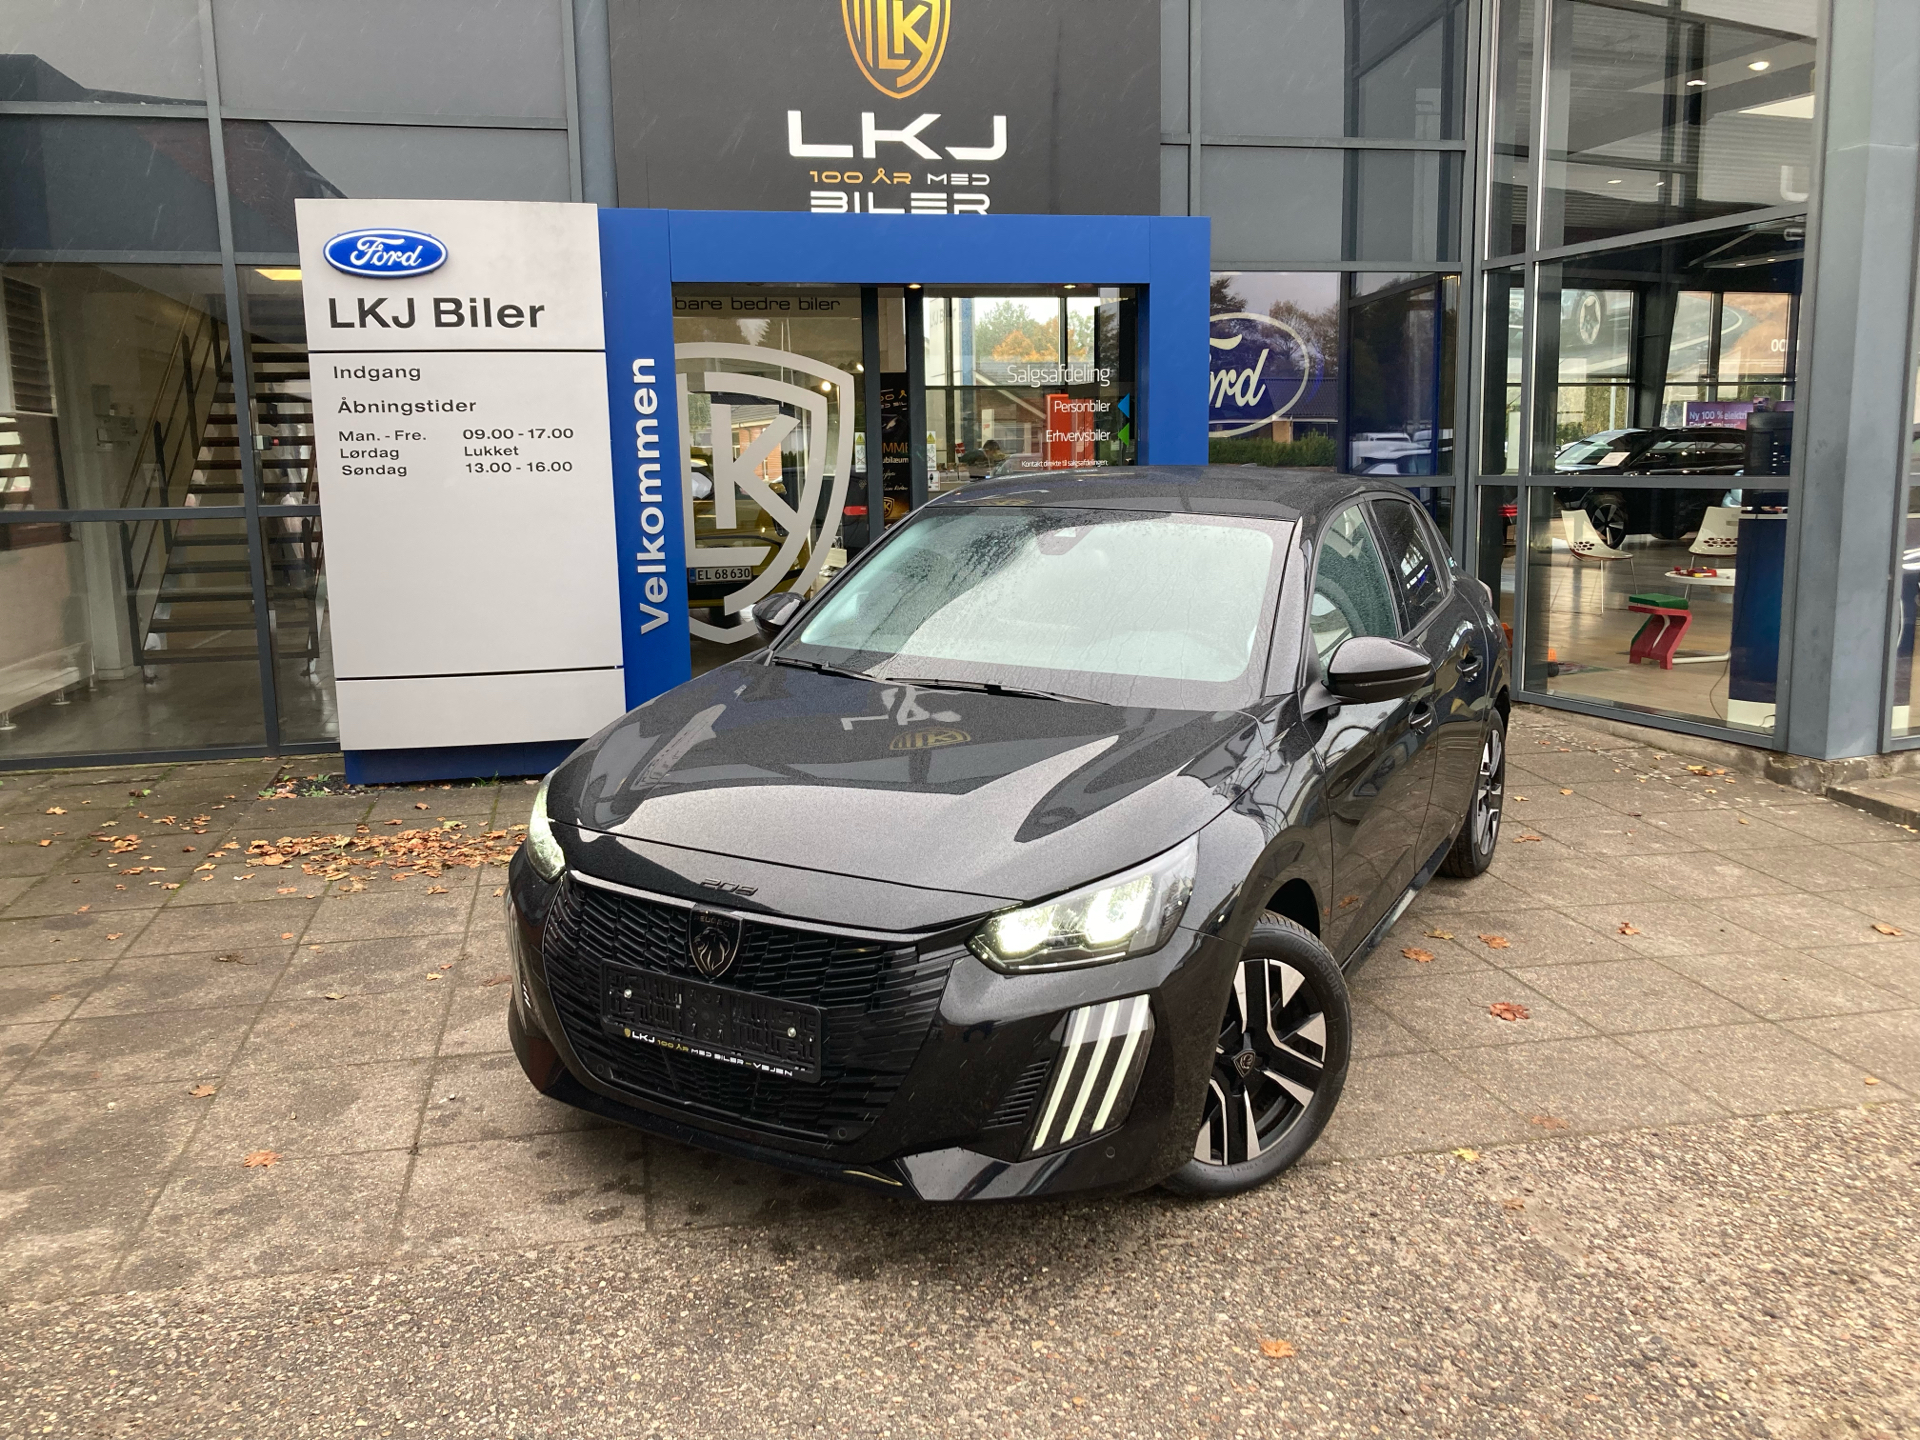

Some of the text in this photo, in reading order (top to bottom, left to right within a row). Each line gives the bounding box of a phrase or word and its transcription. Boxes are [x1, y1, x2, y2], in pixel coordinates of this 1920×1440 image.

[788, 110, 1008, 161] LKJ
[810, 167, 991, 186] 100 ÅR MED
[810, 190, 991, 215] BILER
[350, 236, 423, 267] Ford
[675, 297, 841, 311] bare bedre biler
[328, 297, 545, 329] LKJ Biler
[333, 365, 421, 382] Indgang
[1007, 364, 1111, 388] Salgsafdeling
[338, 396, 477, 416] Åbningstider
[1054, 400, 1111, 413] Personbiler
[1689, 411, 1700, 421] Ny
[1702, 411, 1715, 420] 100
[338, 431, 381, 442] Man.
[395, 430, 427, 441] Fre.
[462, 428, 514, 440] 09.00
[527, 428, 574, 440] 17.00
[1046, 429, 1111, 443] Erhvervsbiler
[340, 448, 399, 460] Lørdag
[464, 445, 519, 457] Lukket
[341, 464, 407, 477] Søndag
[465, 462, 512, 473] 13.00
[526, 461, 573, 473] 16.00
[632, 358, 669, 635] Velkommen
[697, 567, 751, 580] EL 68 630
[632, 1030, 655, 1043] LKJ
[657, 1040, 674, 1049] 100
[690, 1048, 712, 1057] MED
[714, 1053, 744, 1065] BILER
[753, 1062, 792, 1077] VEJEN
